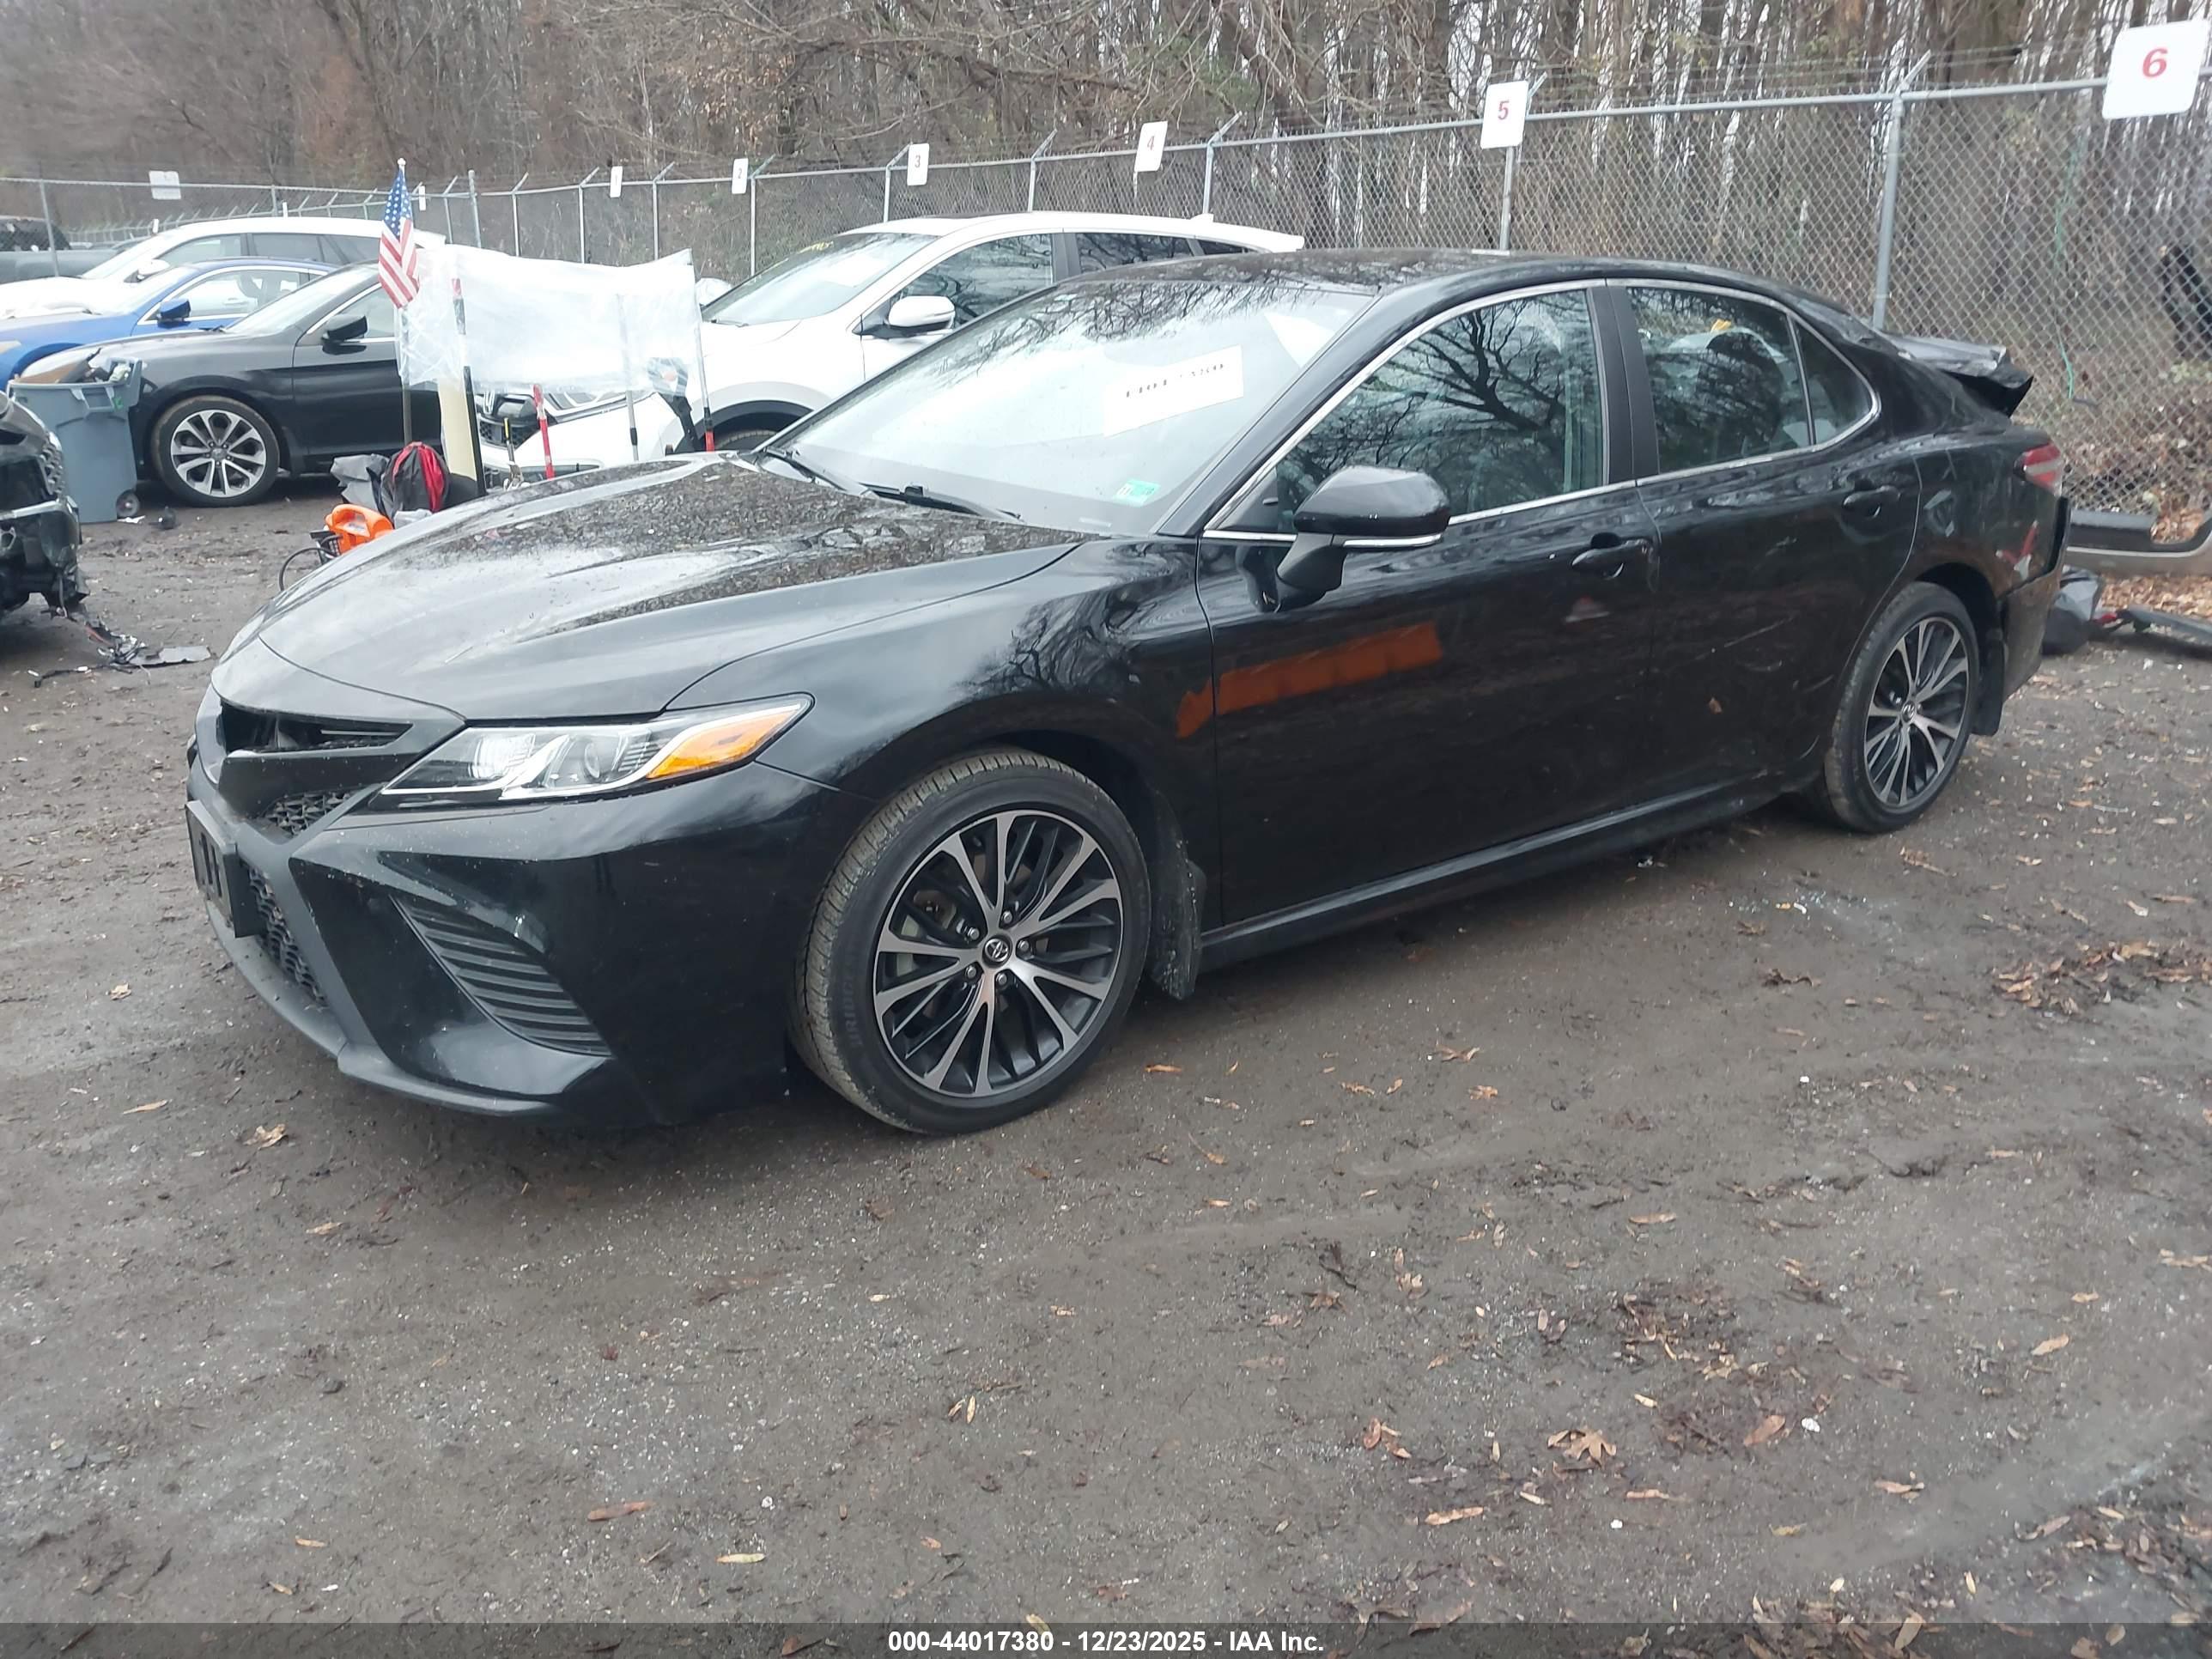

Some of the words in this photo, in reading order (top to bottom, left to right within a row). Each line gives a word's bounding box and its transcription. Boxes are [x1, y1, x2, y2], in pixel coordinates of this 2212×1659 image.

[2142, 47, 2168, 78] 6
[1498, 99, 1510, 120] 5
[1146, 135, 1155, 151] 4
[915, 154, 921, 168] 3
[738, 167, 743, 179] 2
